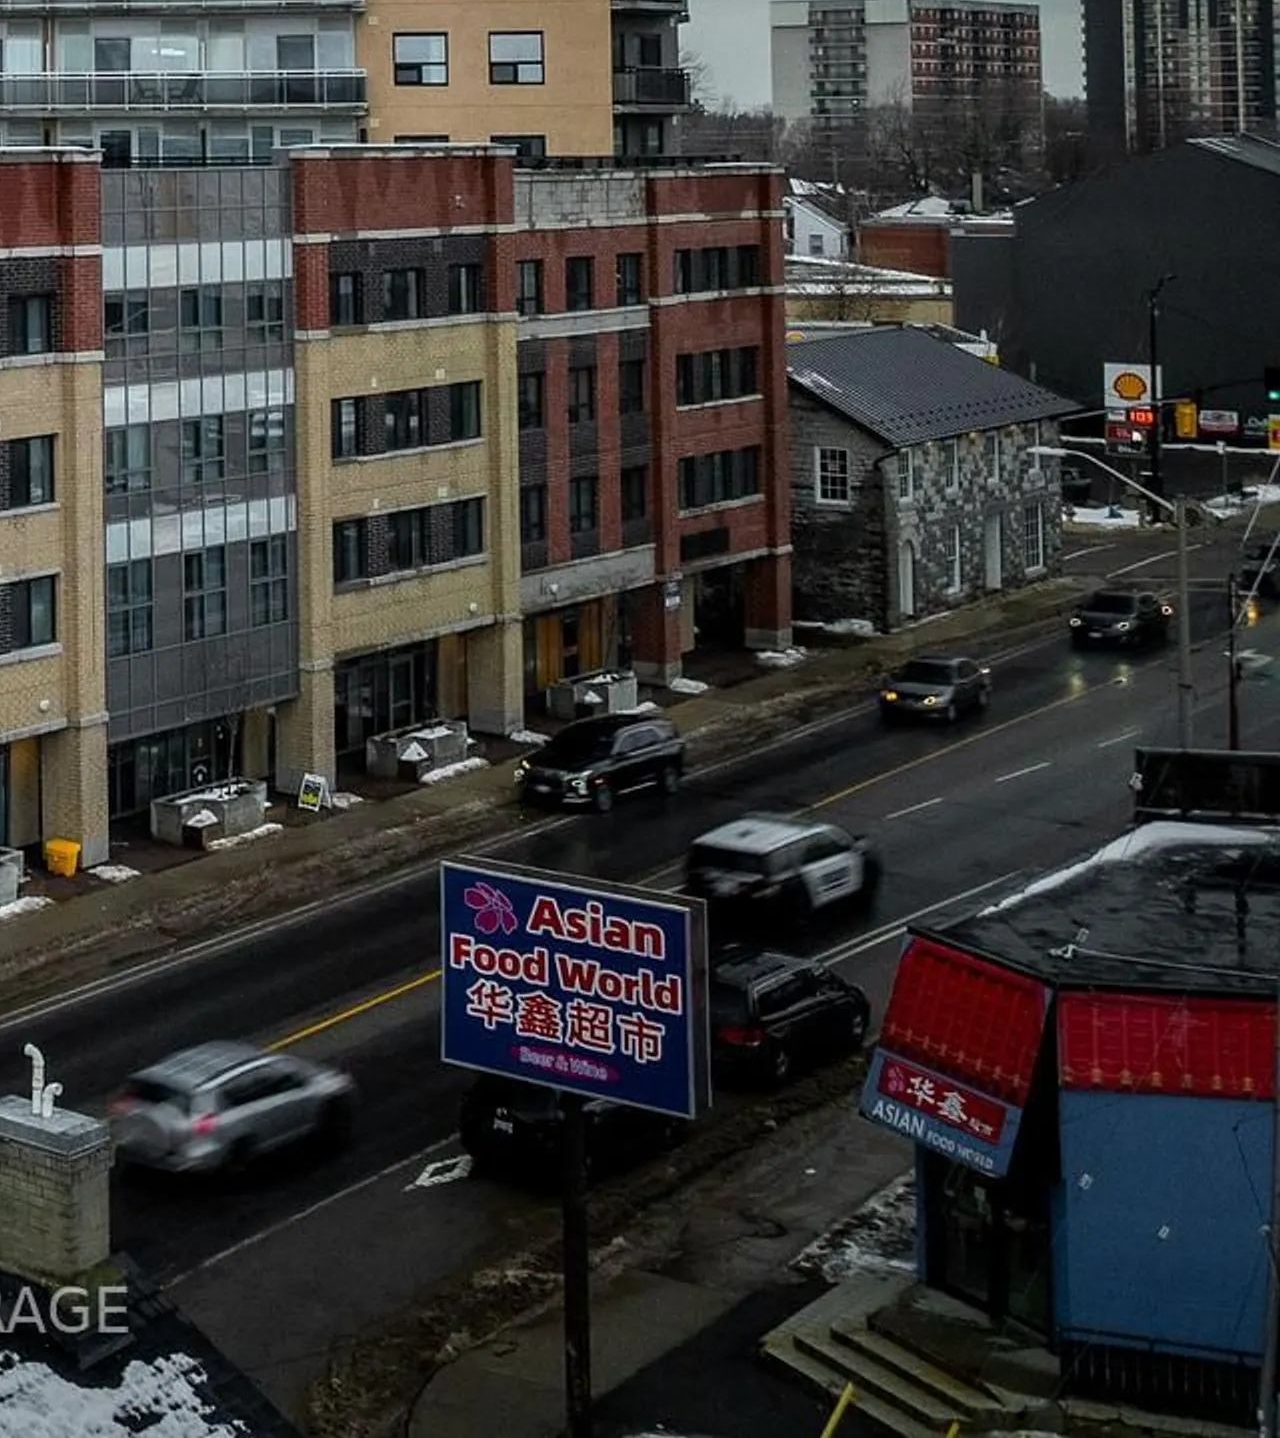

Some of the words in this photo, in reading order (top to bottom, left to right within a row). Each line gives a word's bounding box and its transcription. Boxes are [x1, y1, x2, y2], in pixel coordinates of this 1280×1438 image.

[527, 896, 666, 959] Asian
[451, 933, 547, 986] Food
[555, 957, 683, 1015] World
[466, 978, 665, 1063] 华鑫超市
[872, 1100, 925, 1139] ASIAN
